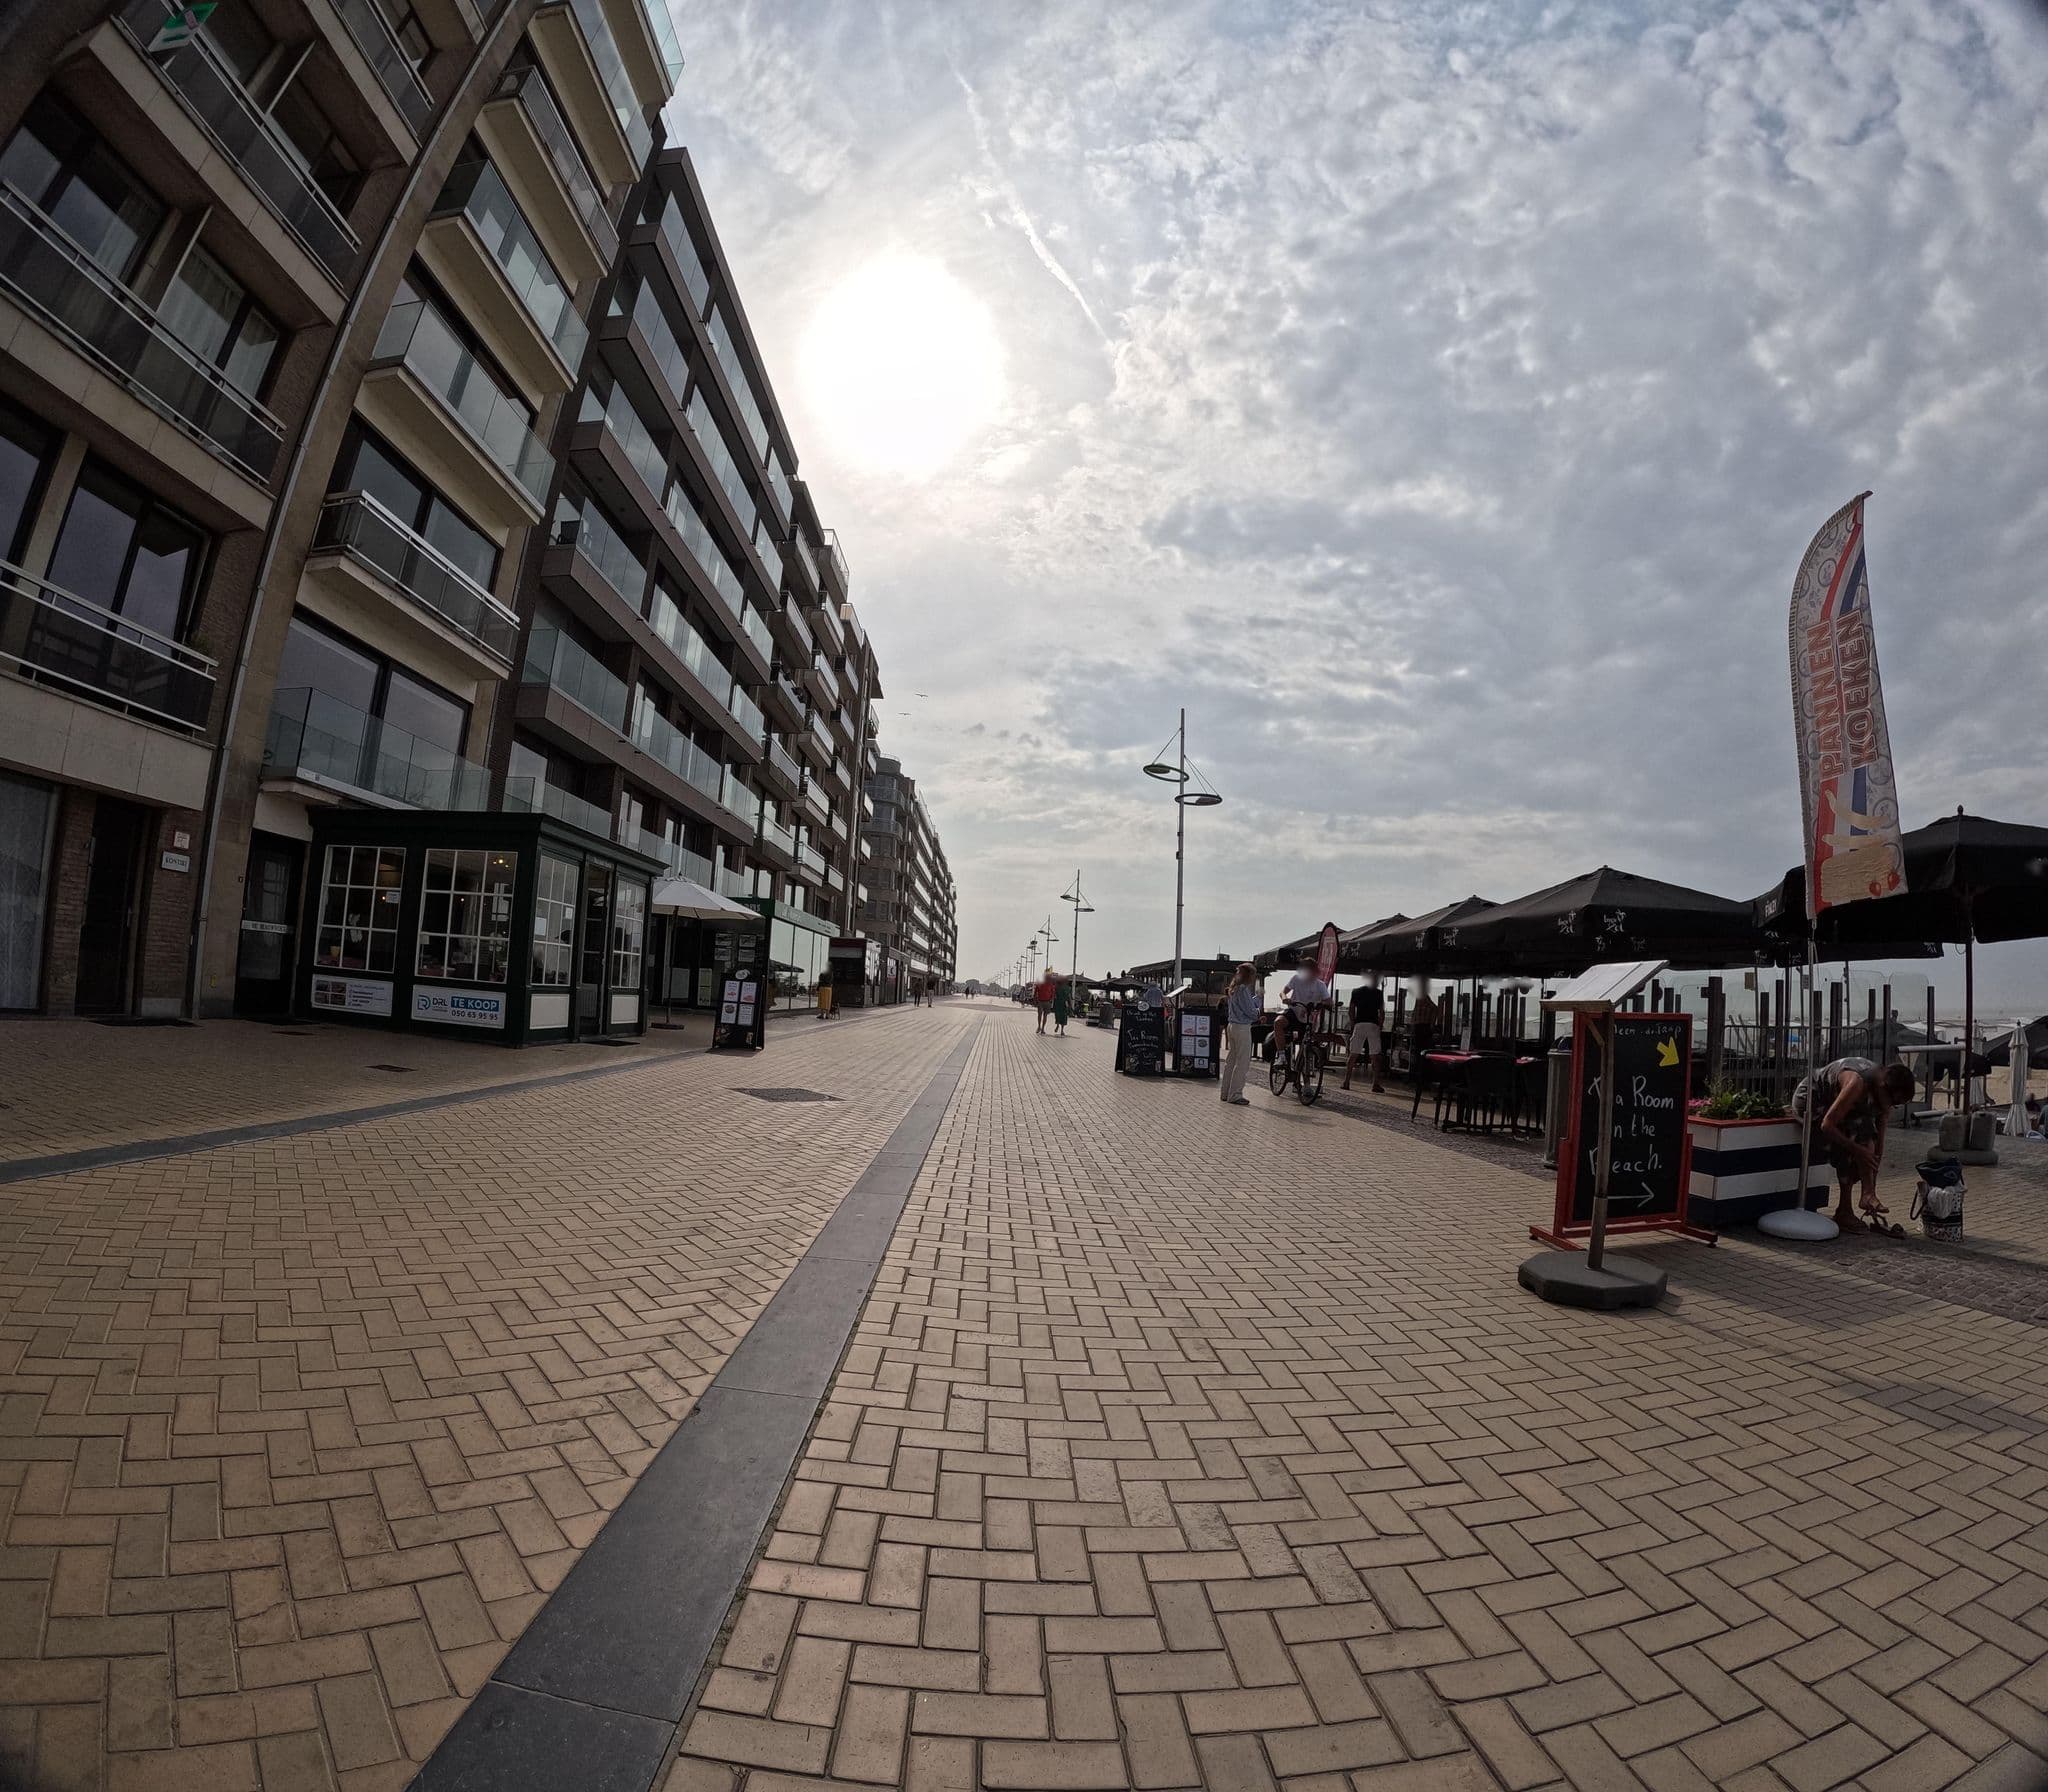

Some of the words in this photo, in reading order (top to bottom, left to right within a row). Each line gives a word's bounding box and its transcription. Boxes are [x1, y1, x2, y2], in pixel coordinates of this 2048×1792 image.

[1807, 620, 1844, 781] PANNEN
[1836, 608, 1879, 769] KOEKEN
[451, 1010, 467, 1018] 050
[453, 998, 466, 1008] TE
[468, 999, 498, 1011] KOOP
[1587, 1076, 1624, 1106] Ta
[1632, 1075, 1675, 1111] Room
[1631, 1113, 1656, 1138] the
